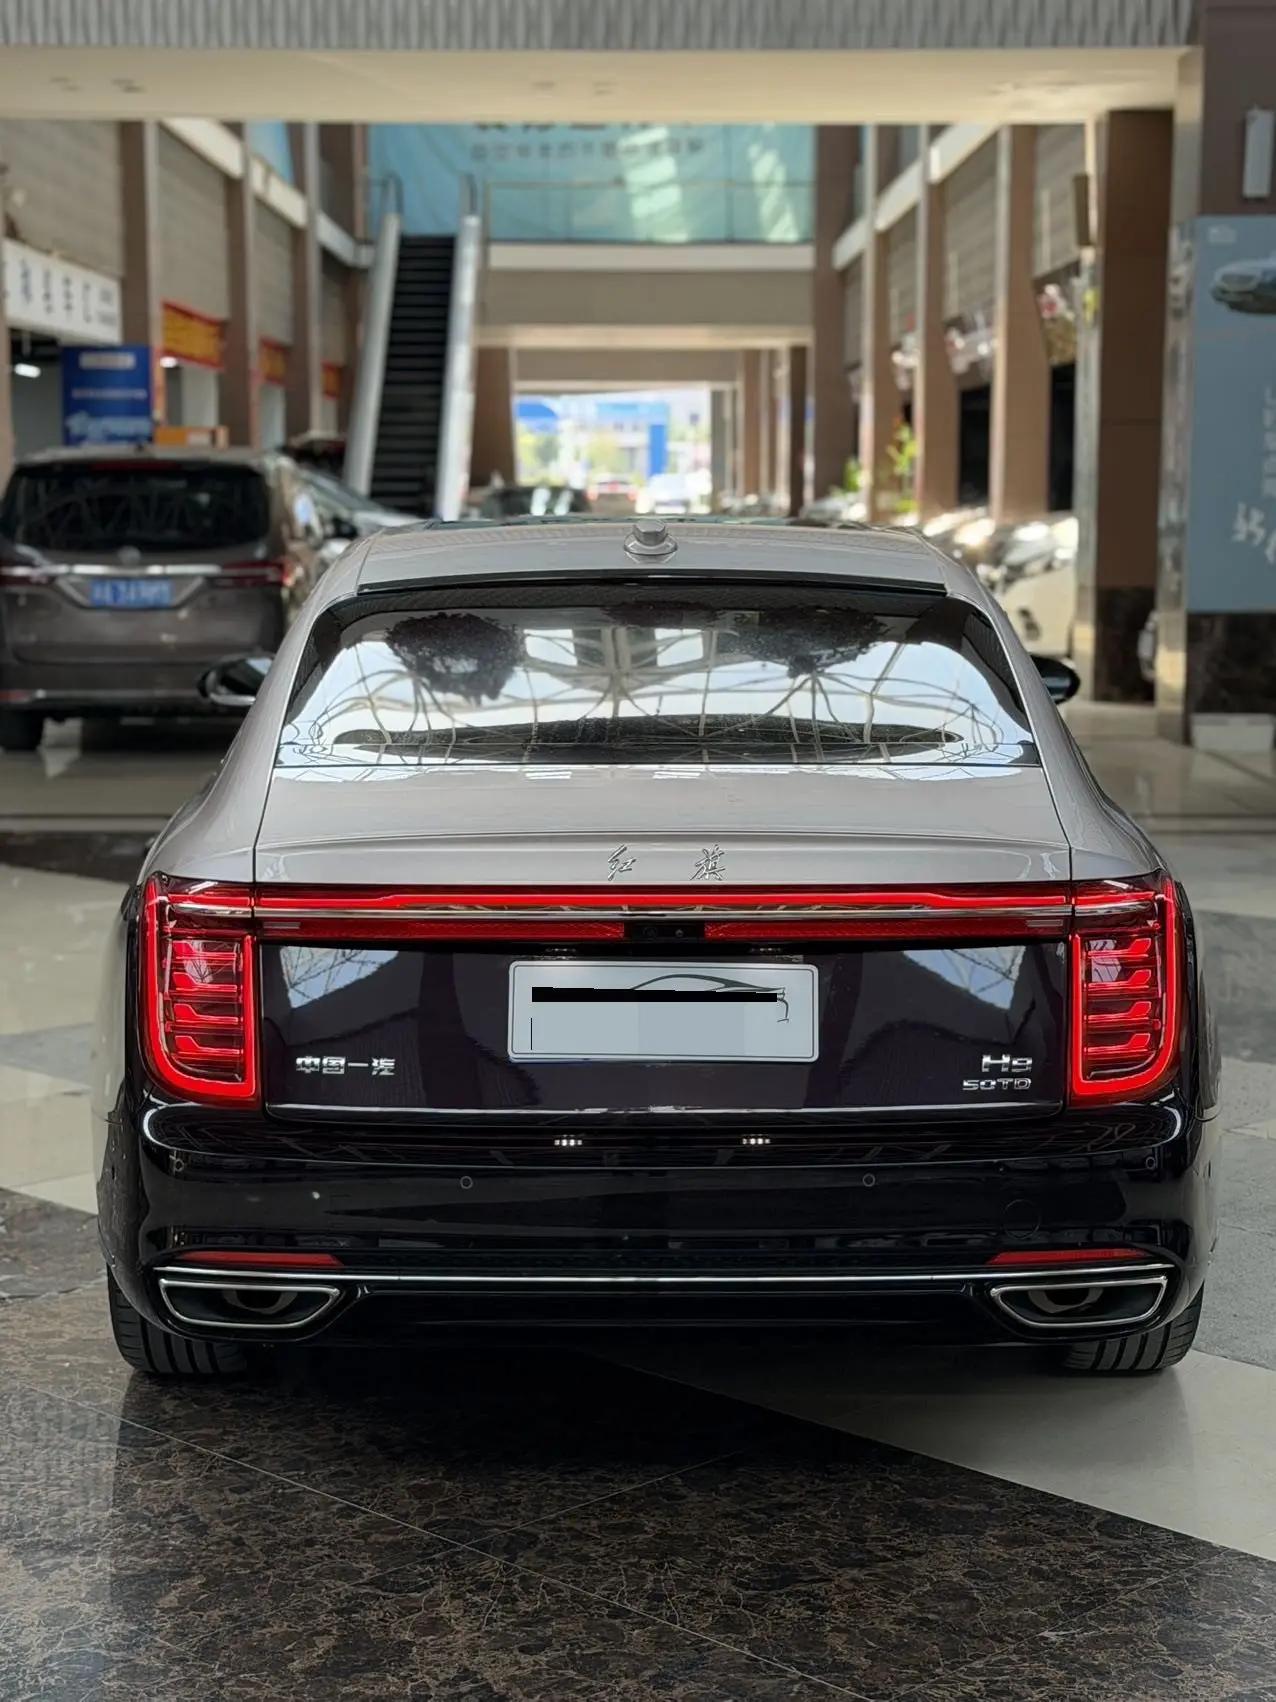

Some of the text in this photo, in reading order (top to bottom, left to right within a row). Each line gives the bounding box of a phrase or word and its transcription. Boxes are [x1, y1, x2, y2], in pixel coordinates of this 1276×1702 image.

[607, 844, 726, 881] 红旗
[296, 1056, 396, 1075] 中国一汽
[982, 1054, 1032, 1072] H9
